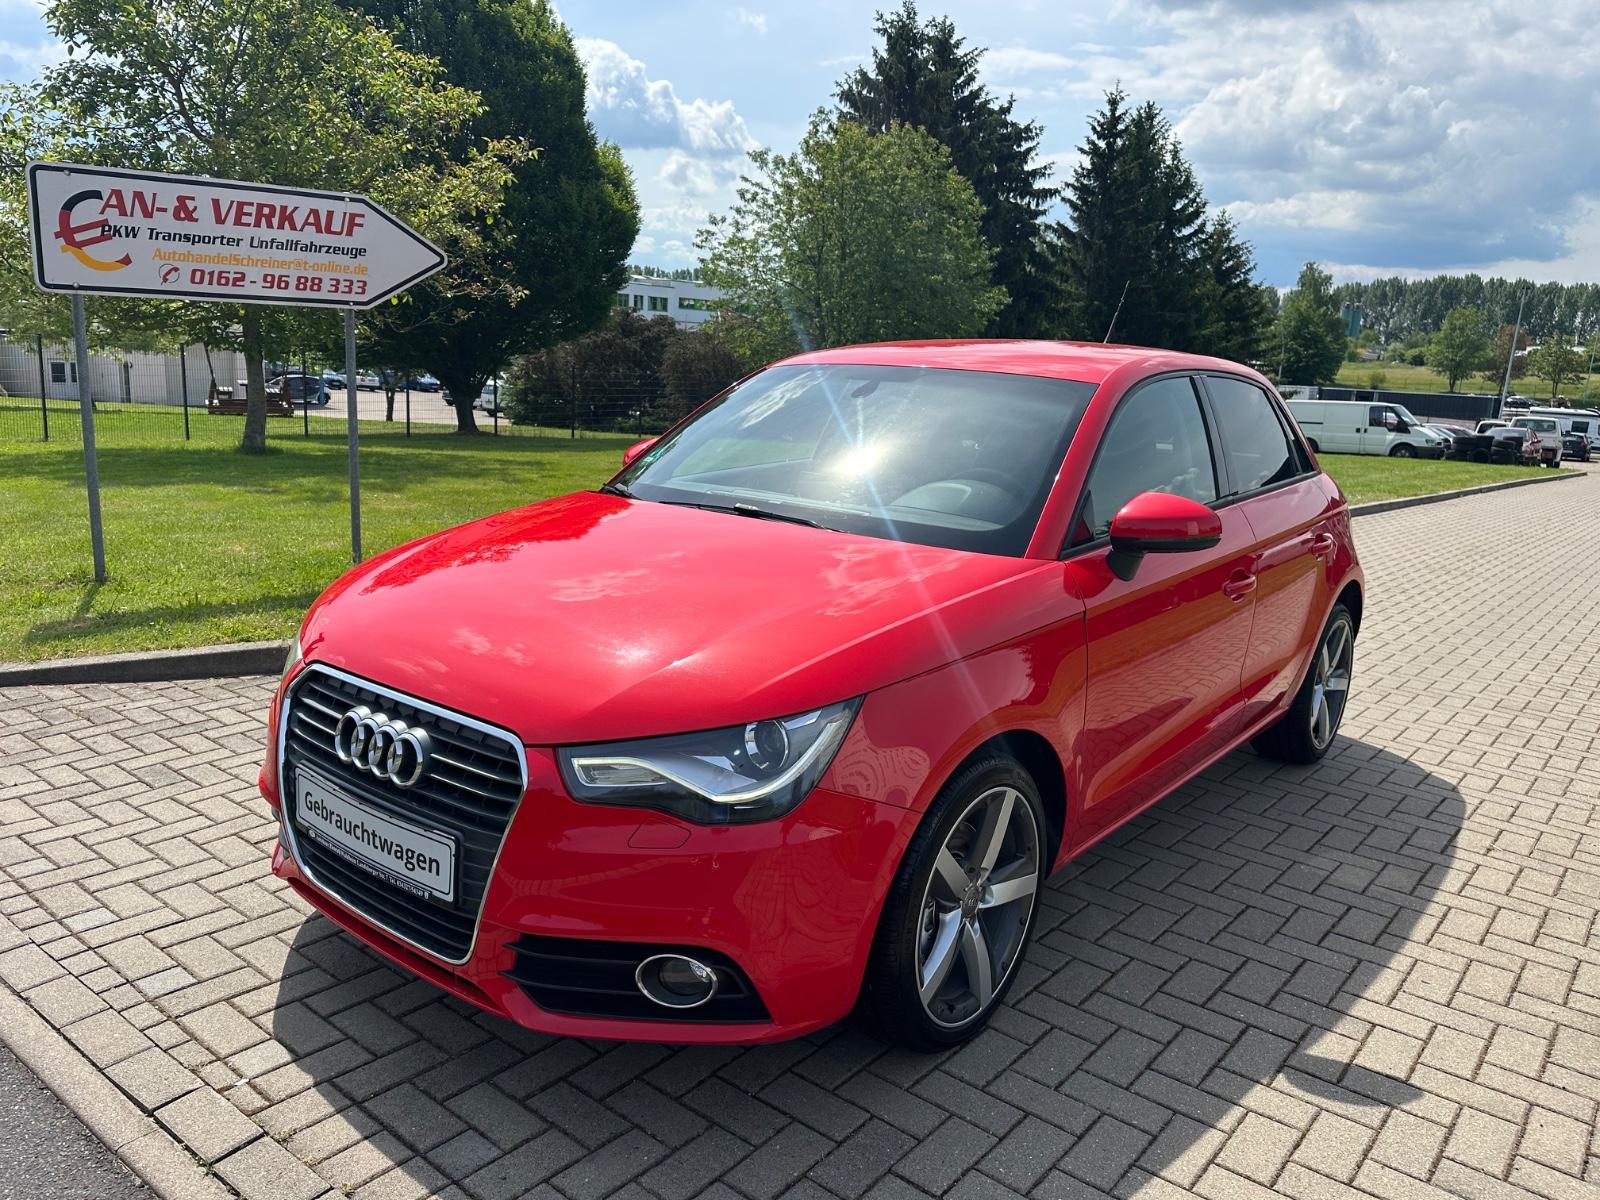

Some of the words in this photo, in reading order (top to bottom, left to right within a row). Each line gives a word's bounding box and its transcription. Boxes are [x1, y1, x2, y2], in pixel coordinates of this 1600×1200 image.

[98, 188, 168, 219] AN-
[172, 195, 199, 223] &
[210, 198, 366, 237] VERKAUF
[100, 224, 141, 239] PKW
[147, 227, 244, 247] Transporter
[249, 236, 367, 259] Unfallfahrzeuge
[152, 247, 369, 275] AutohandelSchreiner@t-online.de
[190, 268, 246, 288] 0162
[261, 273, 290, 290] 96
[295, 275, 323, 292] 88
[327, 278, 368, 295] 333
[304, 791, 440, 877] Gebrauchtwagen
